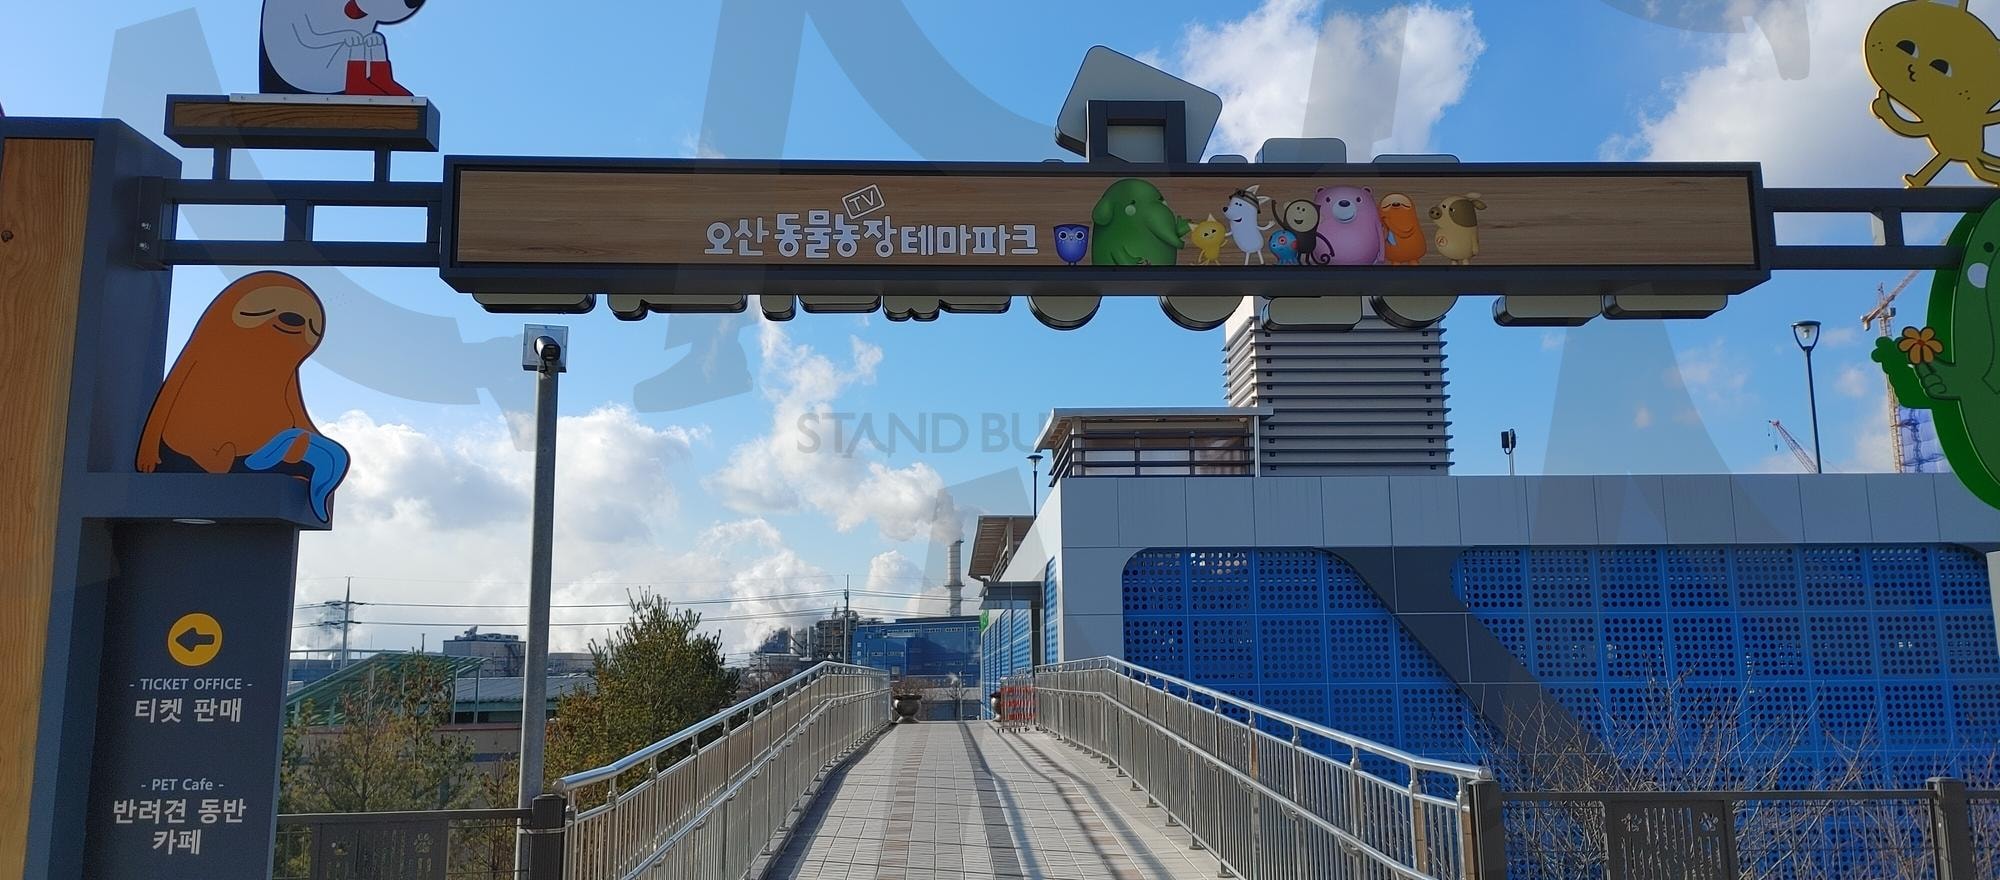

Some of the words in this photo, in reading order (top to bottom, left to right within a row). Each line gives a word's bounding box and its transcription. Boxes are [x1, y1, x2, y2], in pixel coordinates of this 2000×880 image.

[848, 190, 876, 212] TV
[704, 217, 769, 256] 오산
[775, 210, 897, 258] 동물농장
[901, 225, 1038, 256] 테마파크
[140, 678, 189, 690] TICKET
[193, 678, 242, 690] OFFICE
[135, 698, 183, 723] 티켓
[193, 698, 242, 723] 판매
[151, 779, 178, 791] PET
[182, 778, 213, 791] Cafe
[113, 799, 186, 824] 반려견
[198, 799, 247, 824] 동반
[152, 829, 202, 855] 카페
